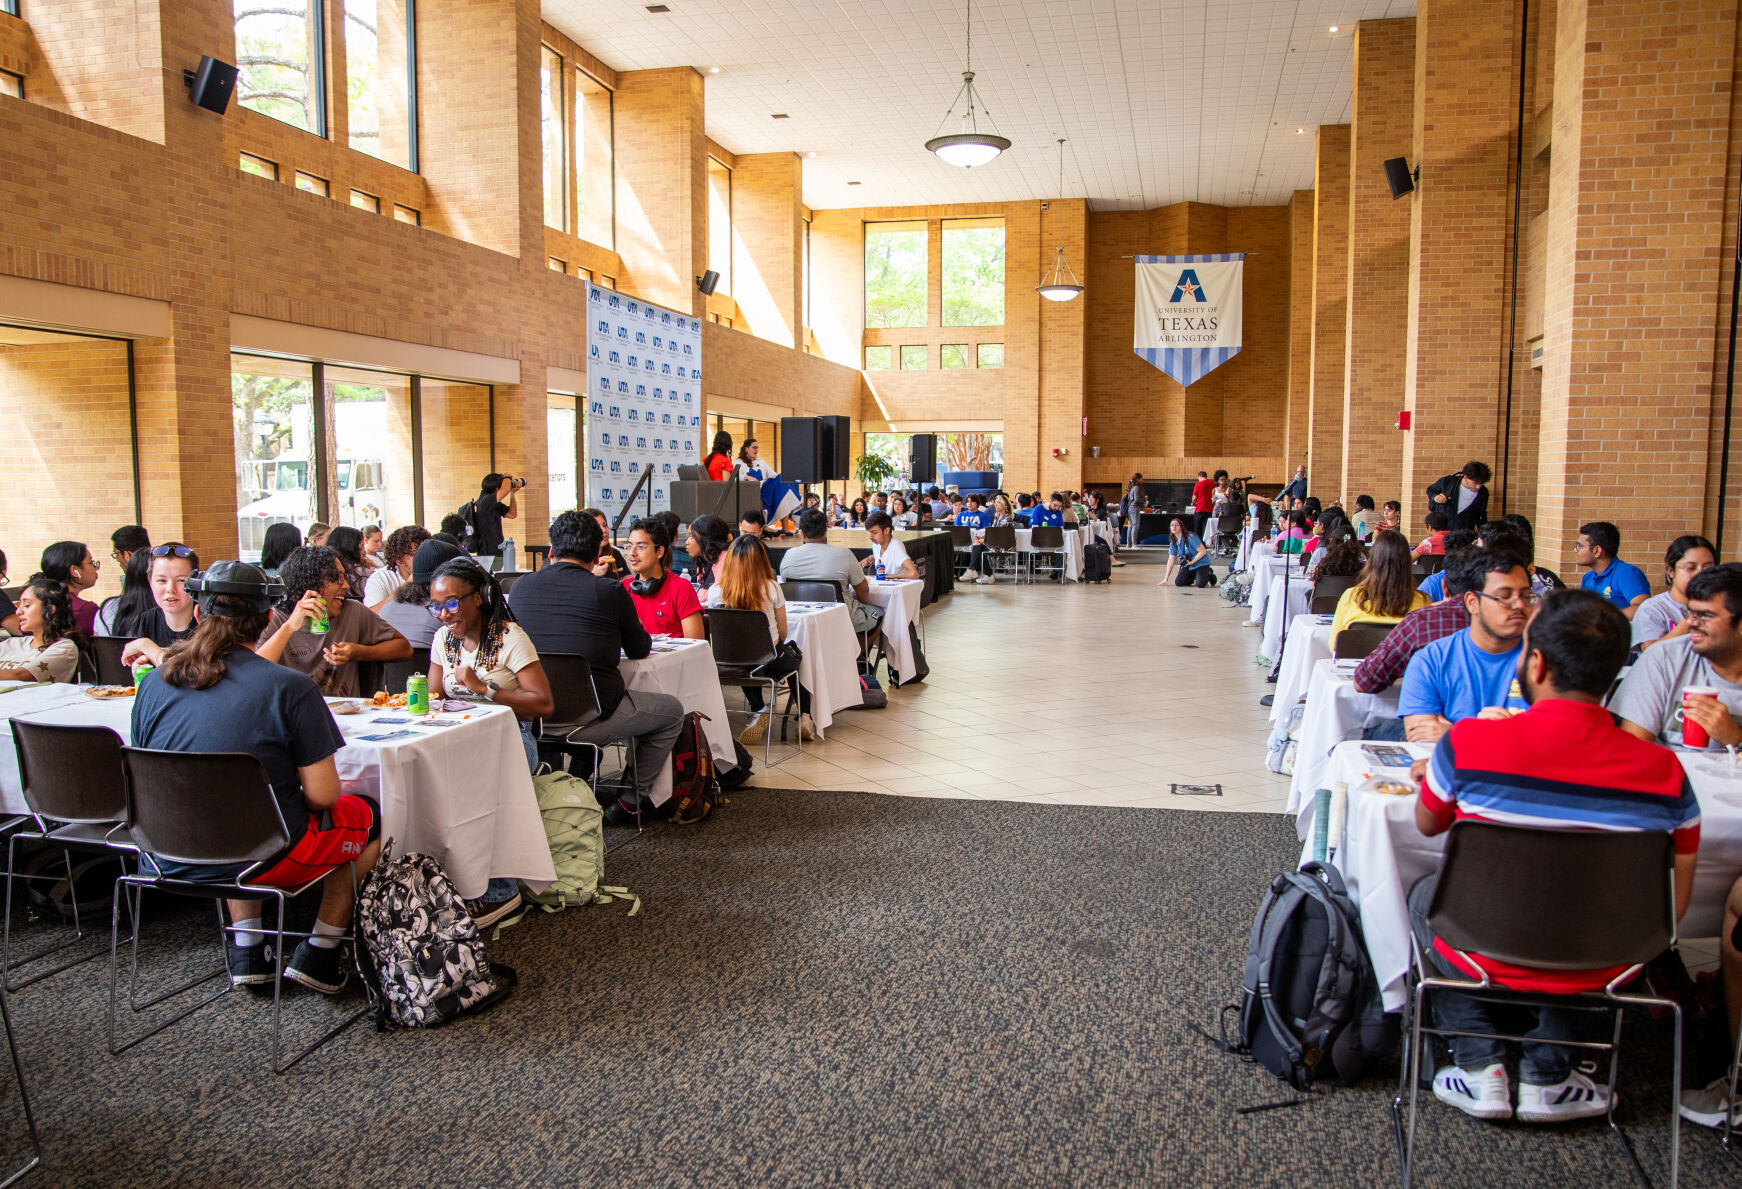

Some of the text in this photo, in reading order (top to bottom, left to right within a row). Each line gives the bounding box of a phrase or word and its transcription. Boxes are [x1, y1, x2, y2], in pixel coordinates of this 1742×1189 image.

[1158, 316, 1218, 331] TEXAS
[1158, 334, 1217, 343] ARLINGTON
[960, 515, 981, 525] UTA
